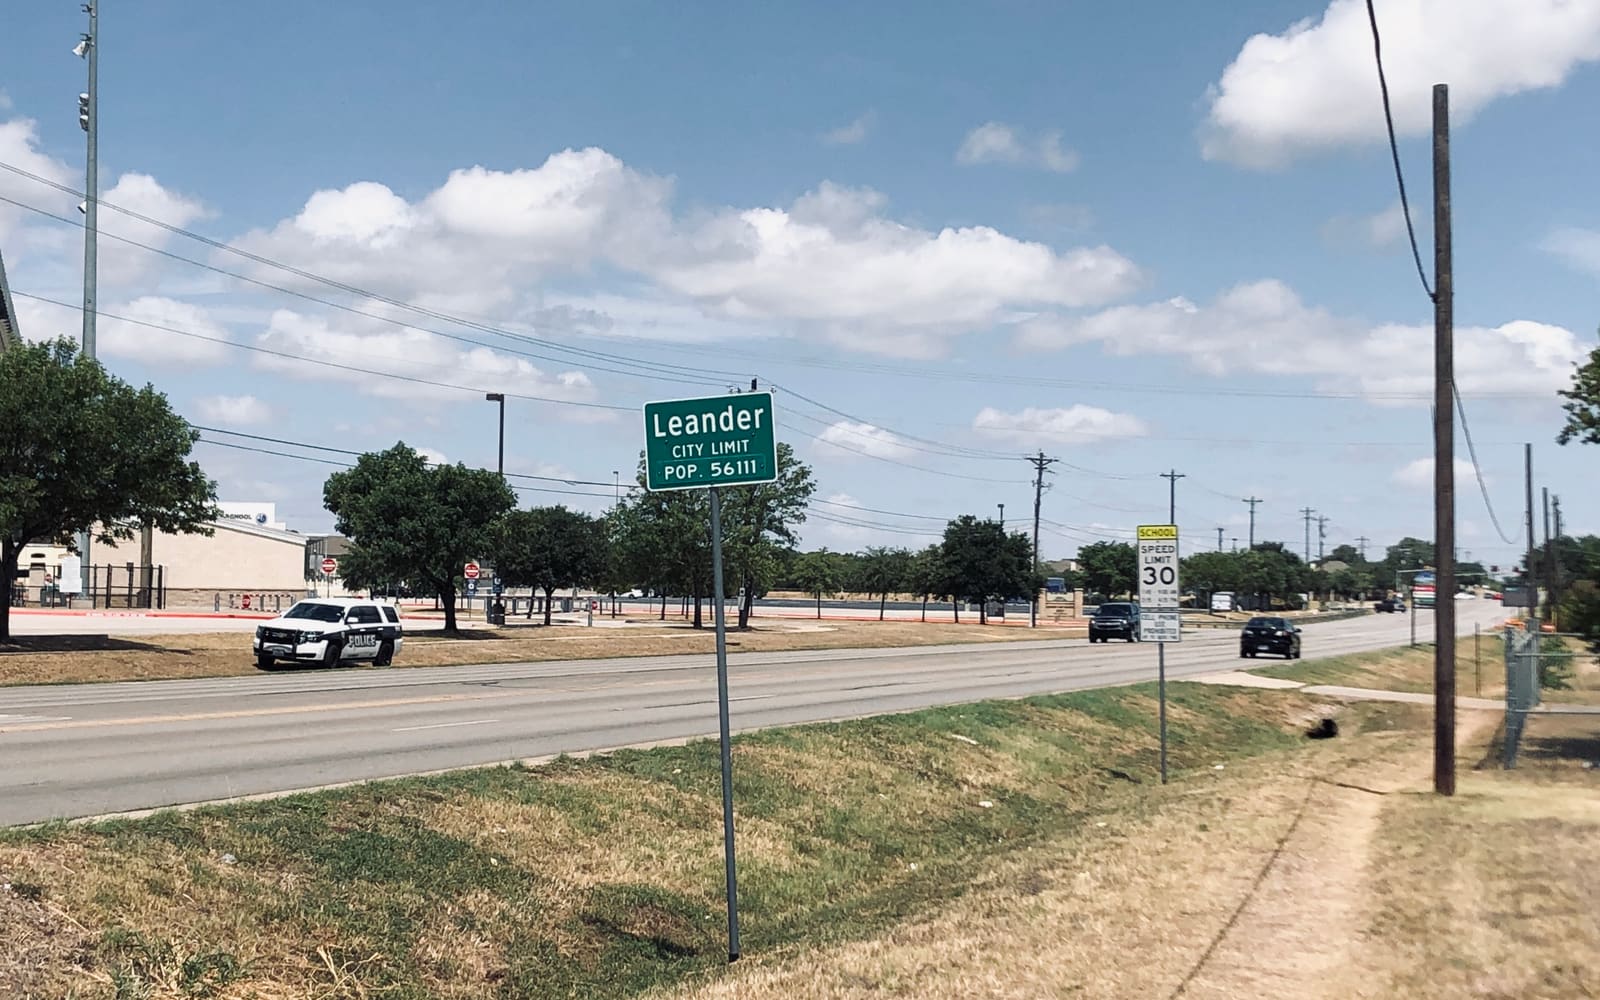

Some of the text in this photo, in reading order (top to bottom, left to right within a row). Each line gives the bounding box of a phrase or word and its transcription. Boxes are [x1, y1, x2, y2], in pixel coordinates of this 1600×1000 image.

[653, 405, 764, 438] Leander
[672, 439, 749, 458] CITY LIMIT
[664, 460, 756, 480] POP. 56111
[1140, 528, 1176, 537] SCHOOL
[1141, 545, 1175, 554] SPEED
[1144, 555, 1172, 565] LIMIT
[1143, 566, 1175, 586] 30
[349, 634, 376, 648] POLICE
